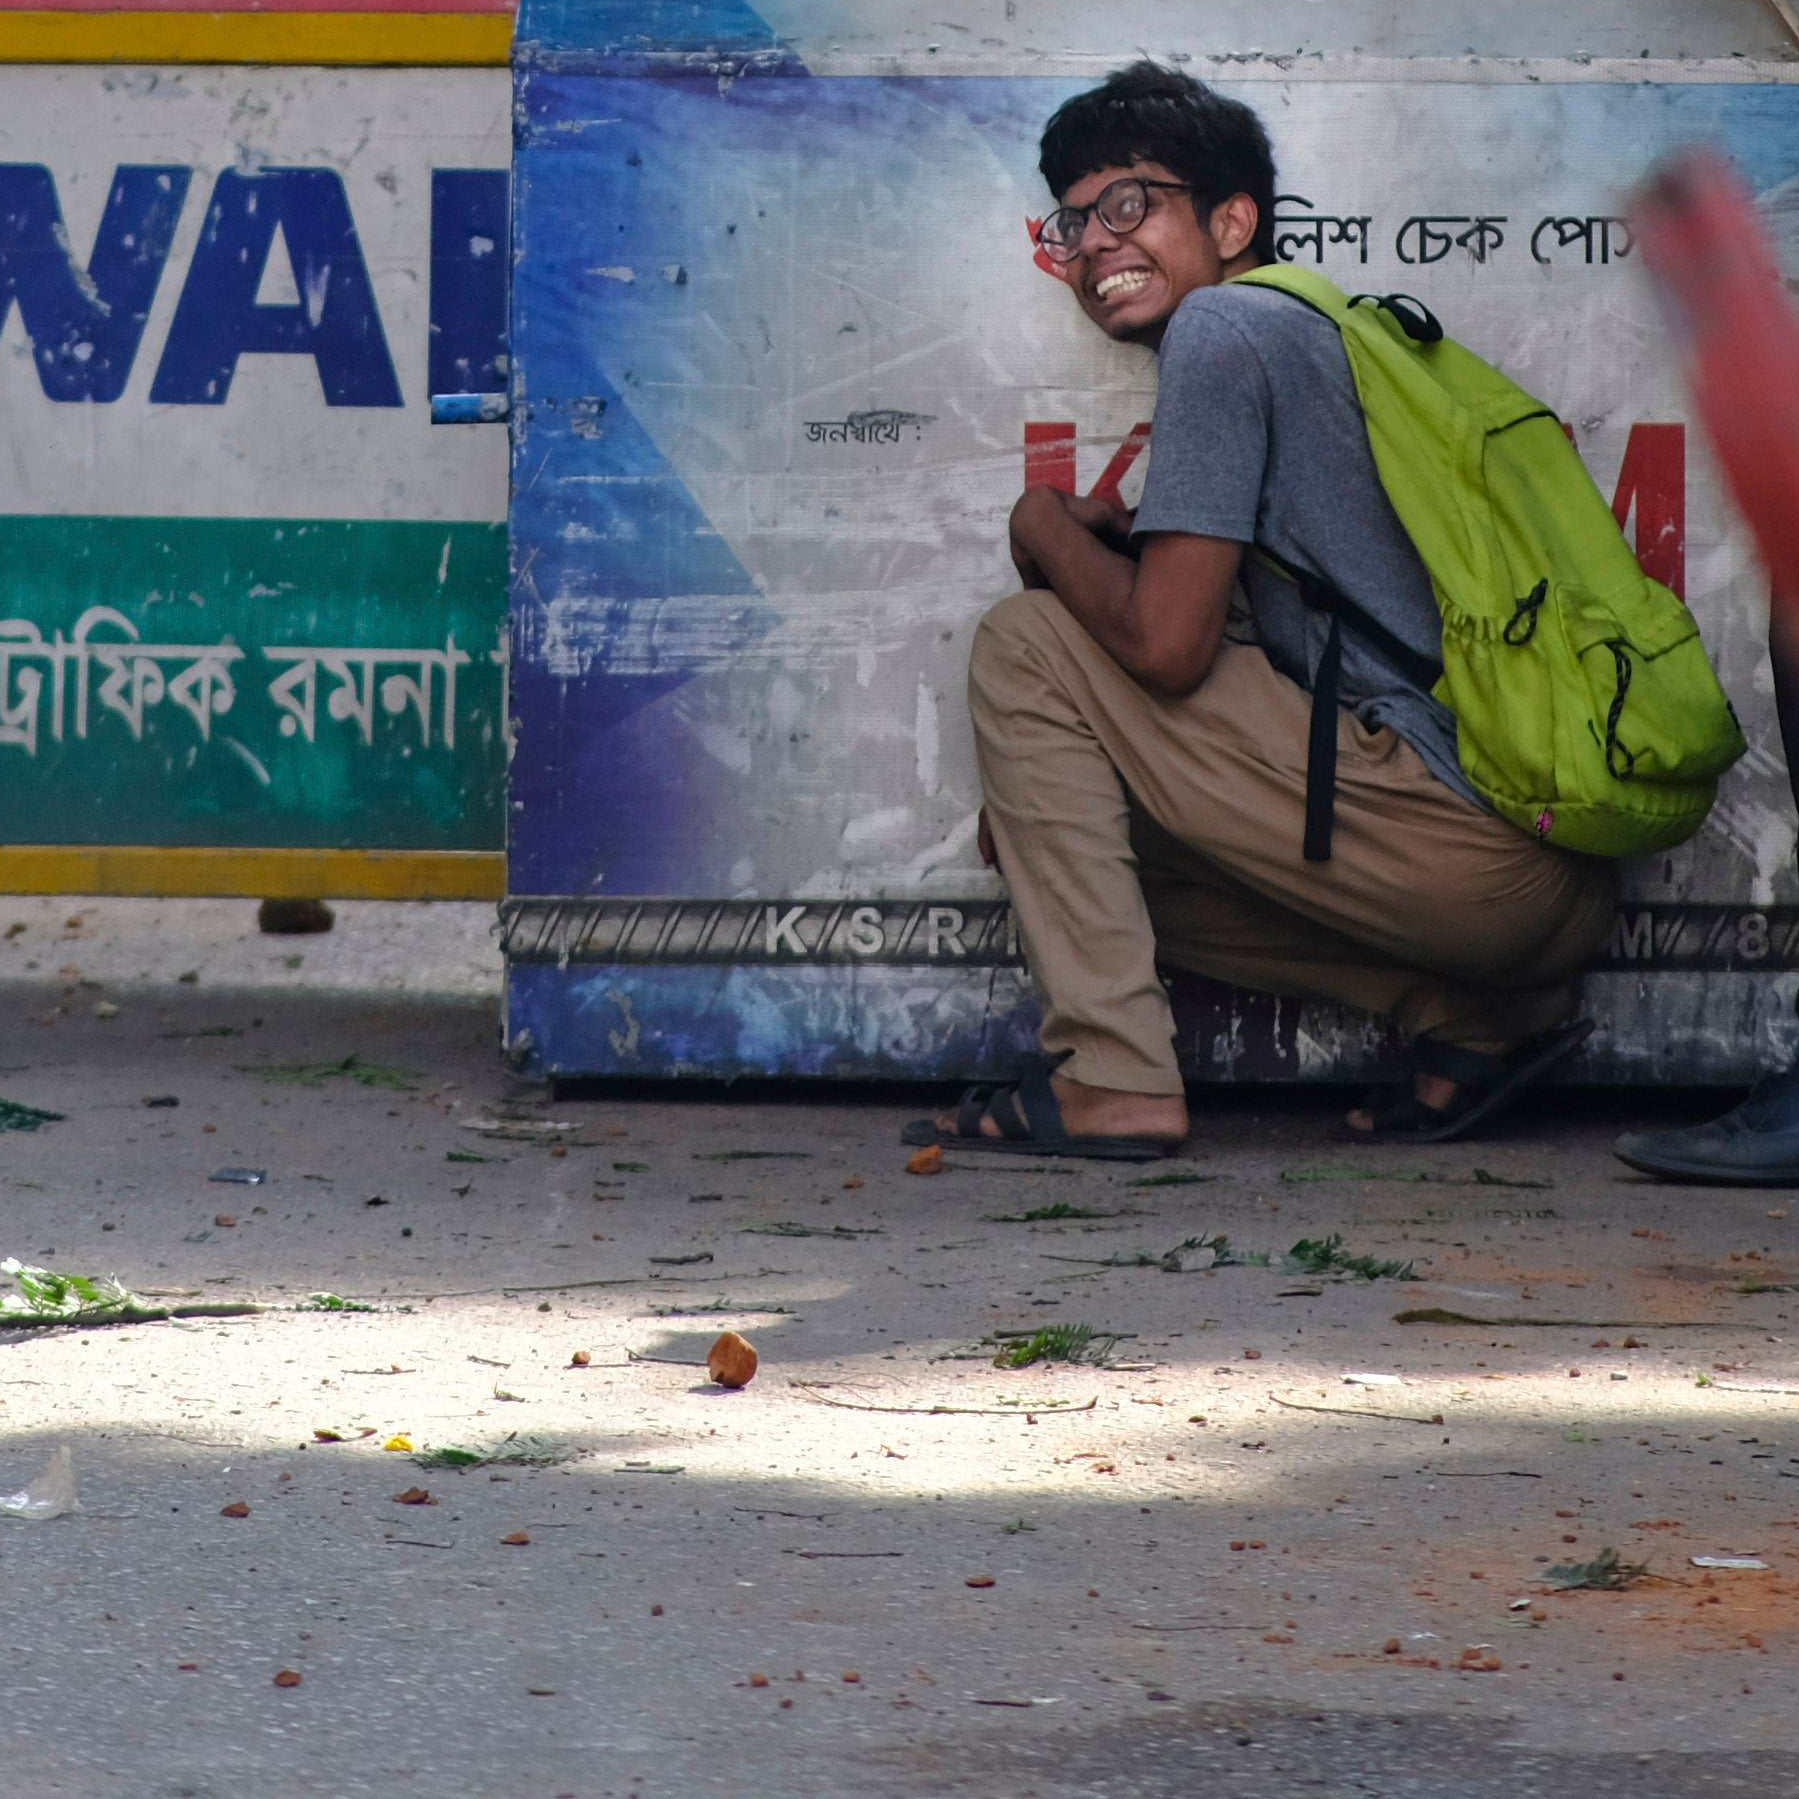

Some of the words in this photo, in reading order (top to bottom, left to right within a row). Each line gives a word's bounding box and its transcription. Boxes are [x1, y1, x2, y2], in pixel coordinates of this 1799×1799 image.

[1273, 193, 1373, 264] লিশ
[1396, 215, 1508, 265] চেক
[262, 634, 473, 750] রমনা
[765, 904, 1027, 958] KSR
